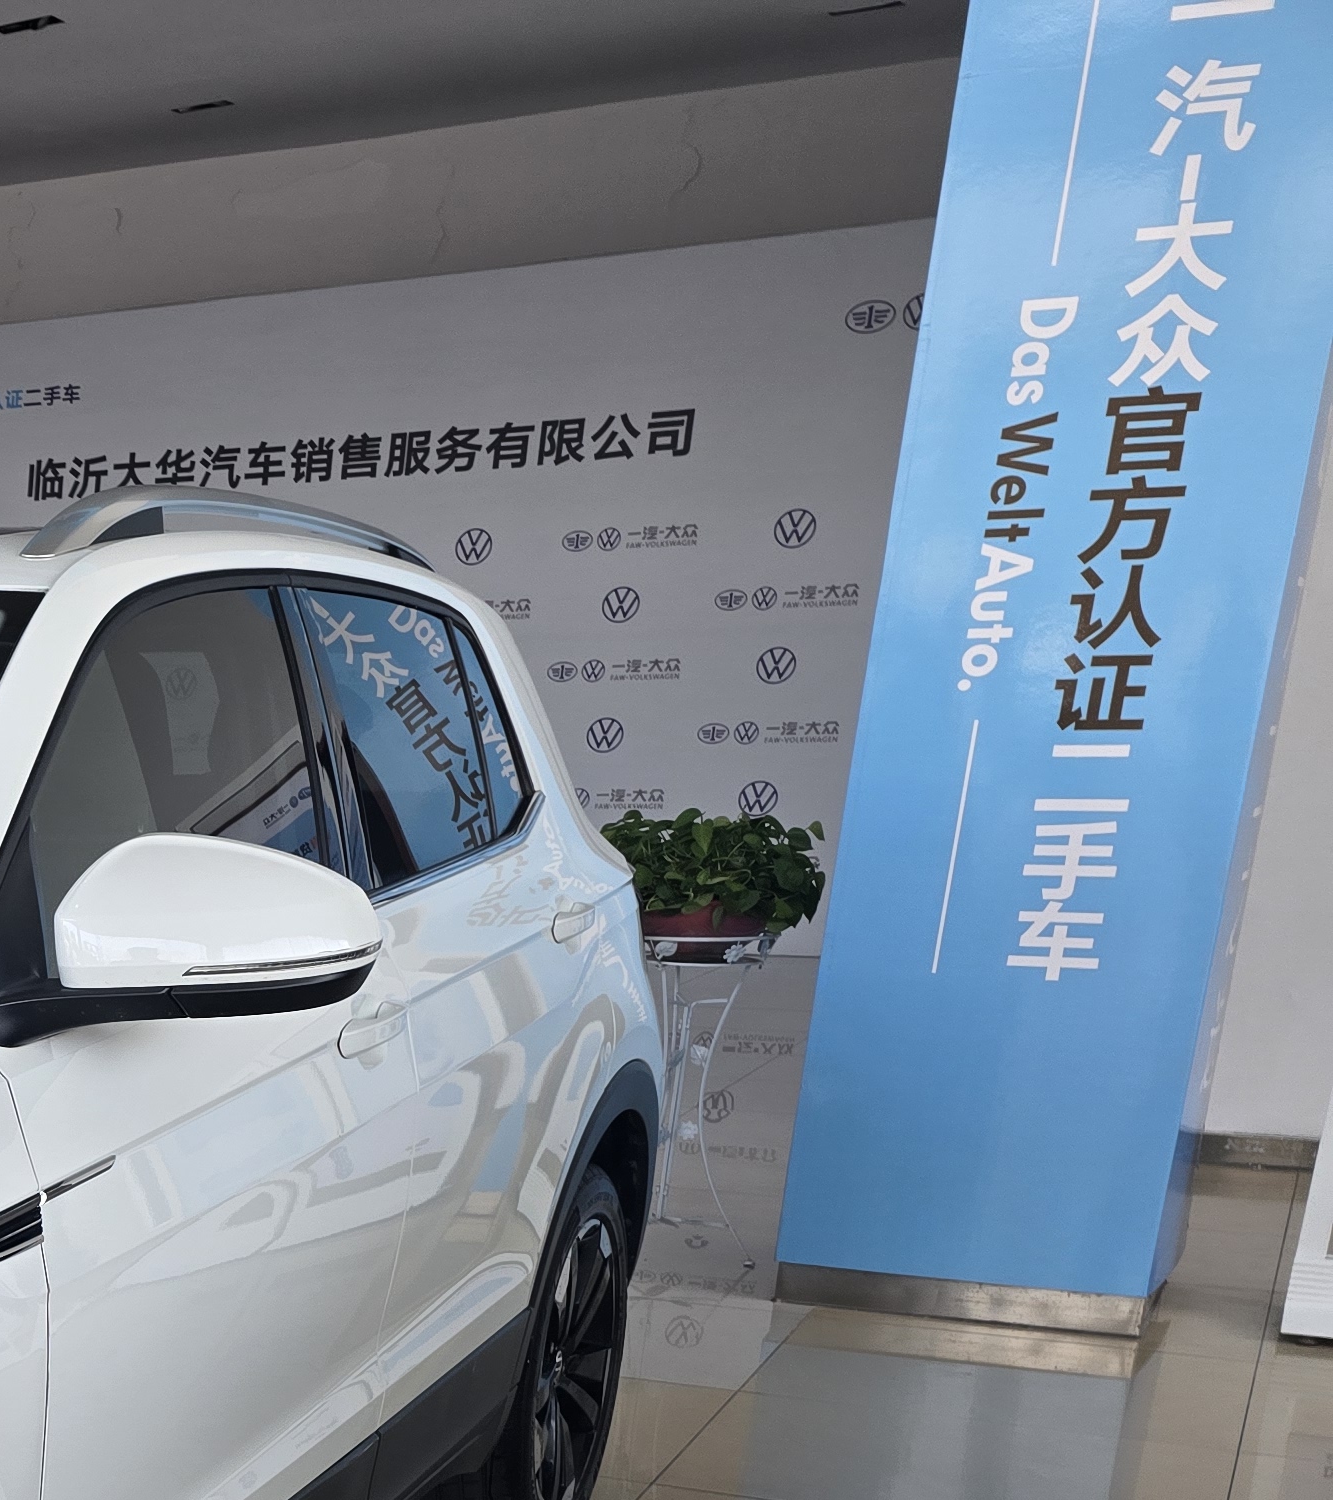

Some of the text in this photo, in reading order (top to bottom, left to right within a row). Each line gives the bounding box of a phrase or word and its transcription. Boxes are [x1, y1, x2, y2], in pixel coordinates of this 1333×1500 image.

[1006, 296, 1080, 407] Das
[27, 408, 696, 501] 临沂大华汽车销售服务有限公司
